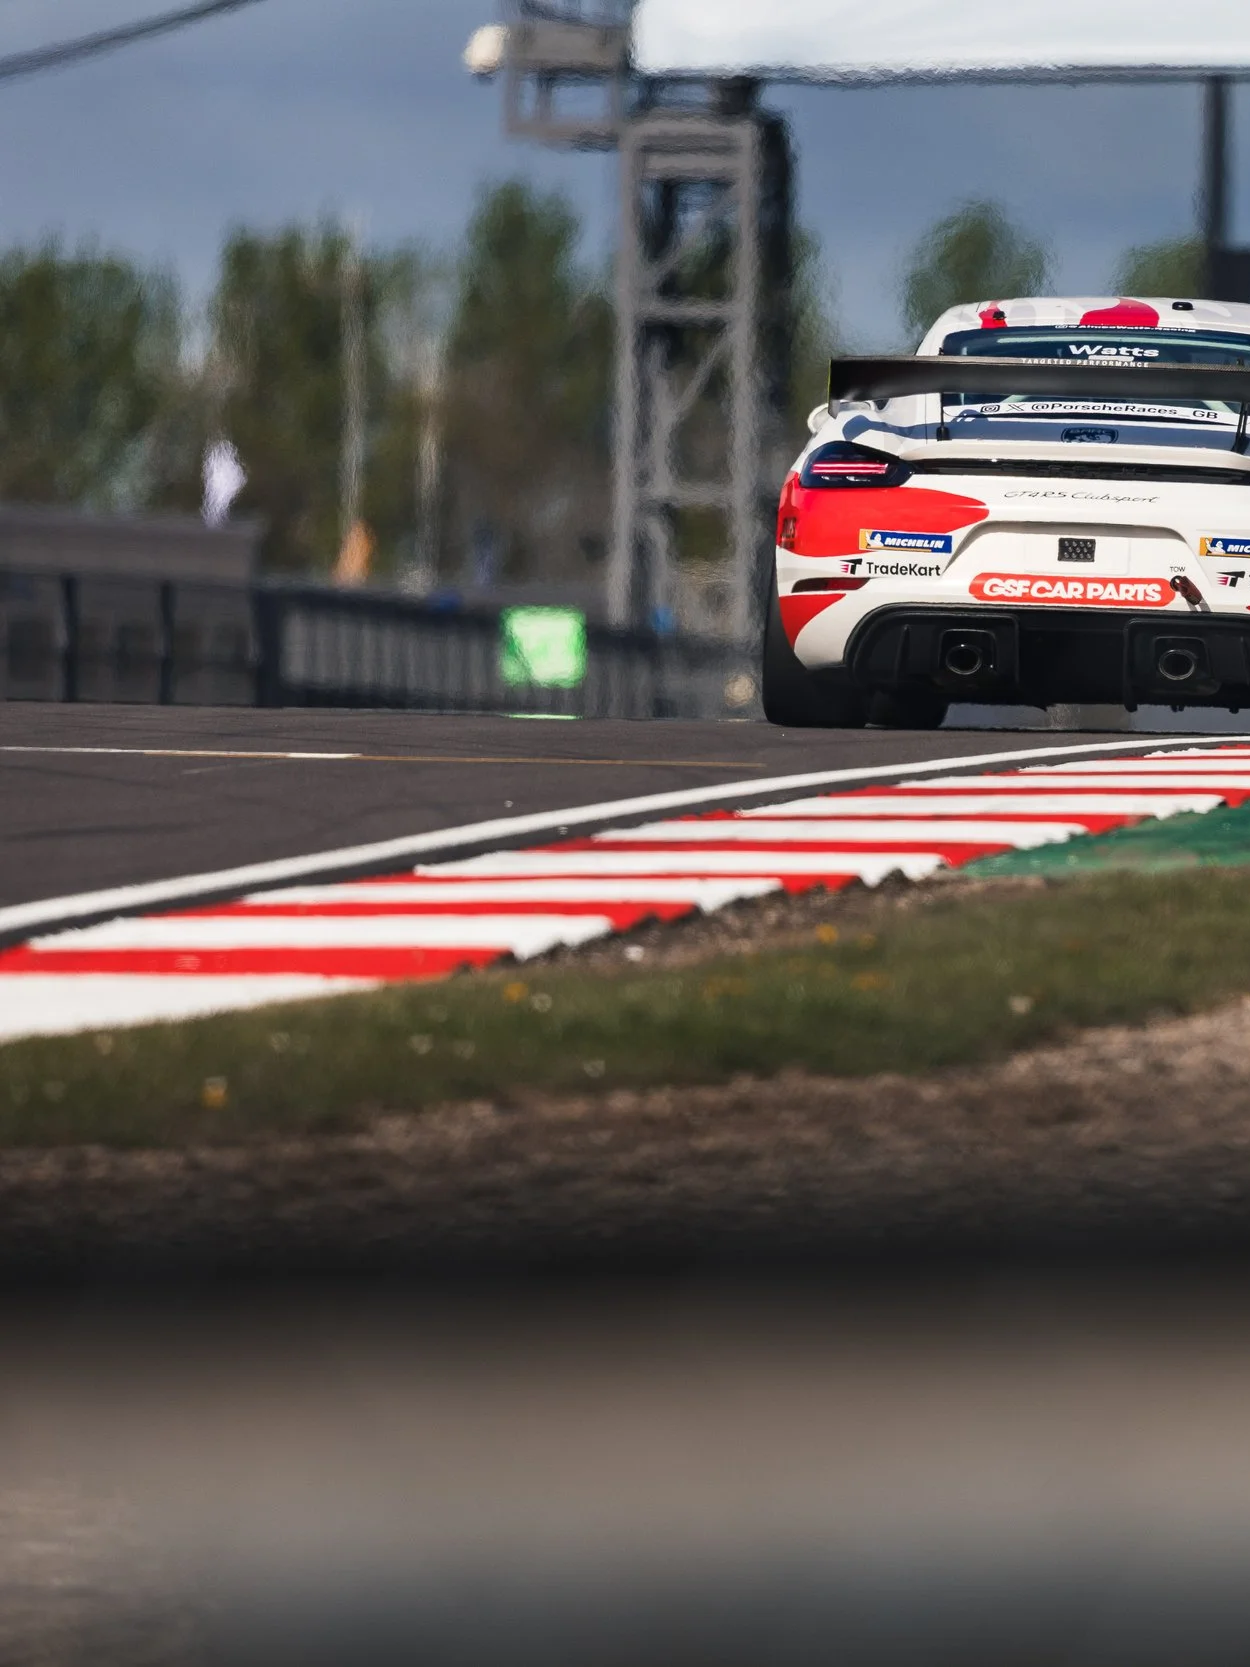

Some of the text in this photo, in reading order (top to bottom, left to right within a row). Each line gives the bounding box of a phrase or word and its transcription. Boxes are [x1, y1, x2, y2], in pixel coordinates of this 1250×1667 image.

[1069, 345, 1159, 357] Watts
[1076, 359, 1149, 368] PERFORMANCE
[1031, 402, 1219, 419] @PorscheRaces_GB
[1071, 491, 1161, 503] Clubsport
[884, 537, 945, 549] MICHELIN
[866, 562, 941, 577] TradeKart
[982, 577, 1162, 602] GSF CAR PARTS
